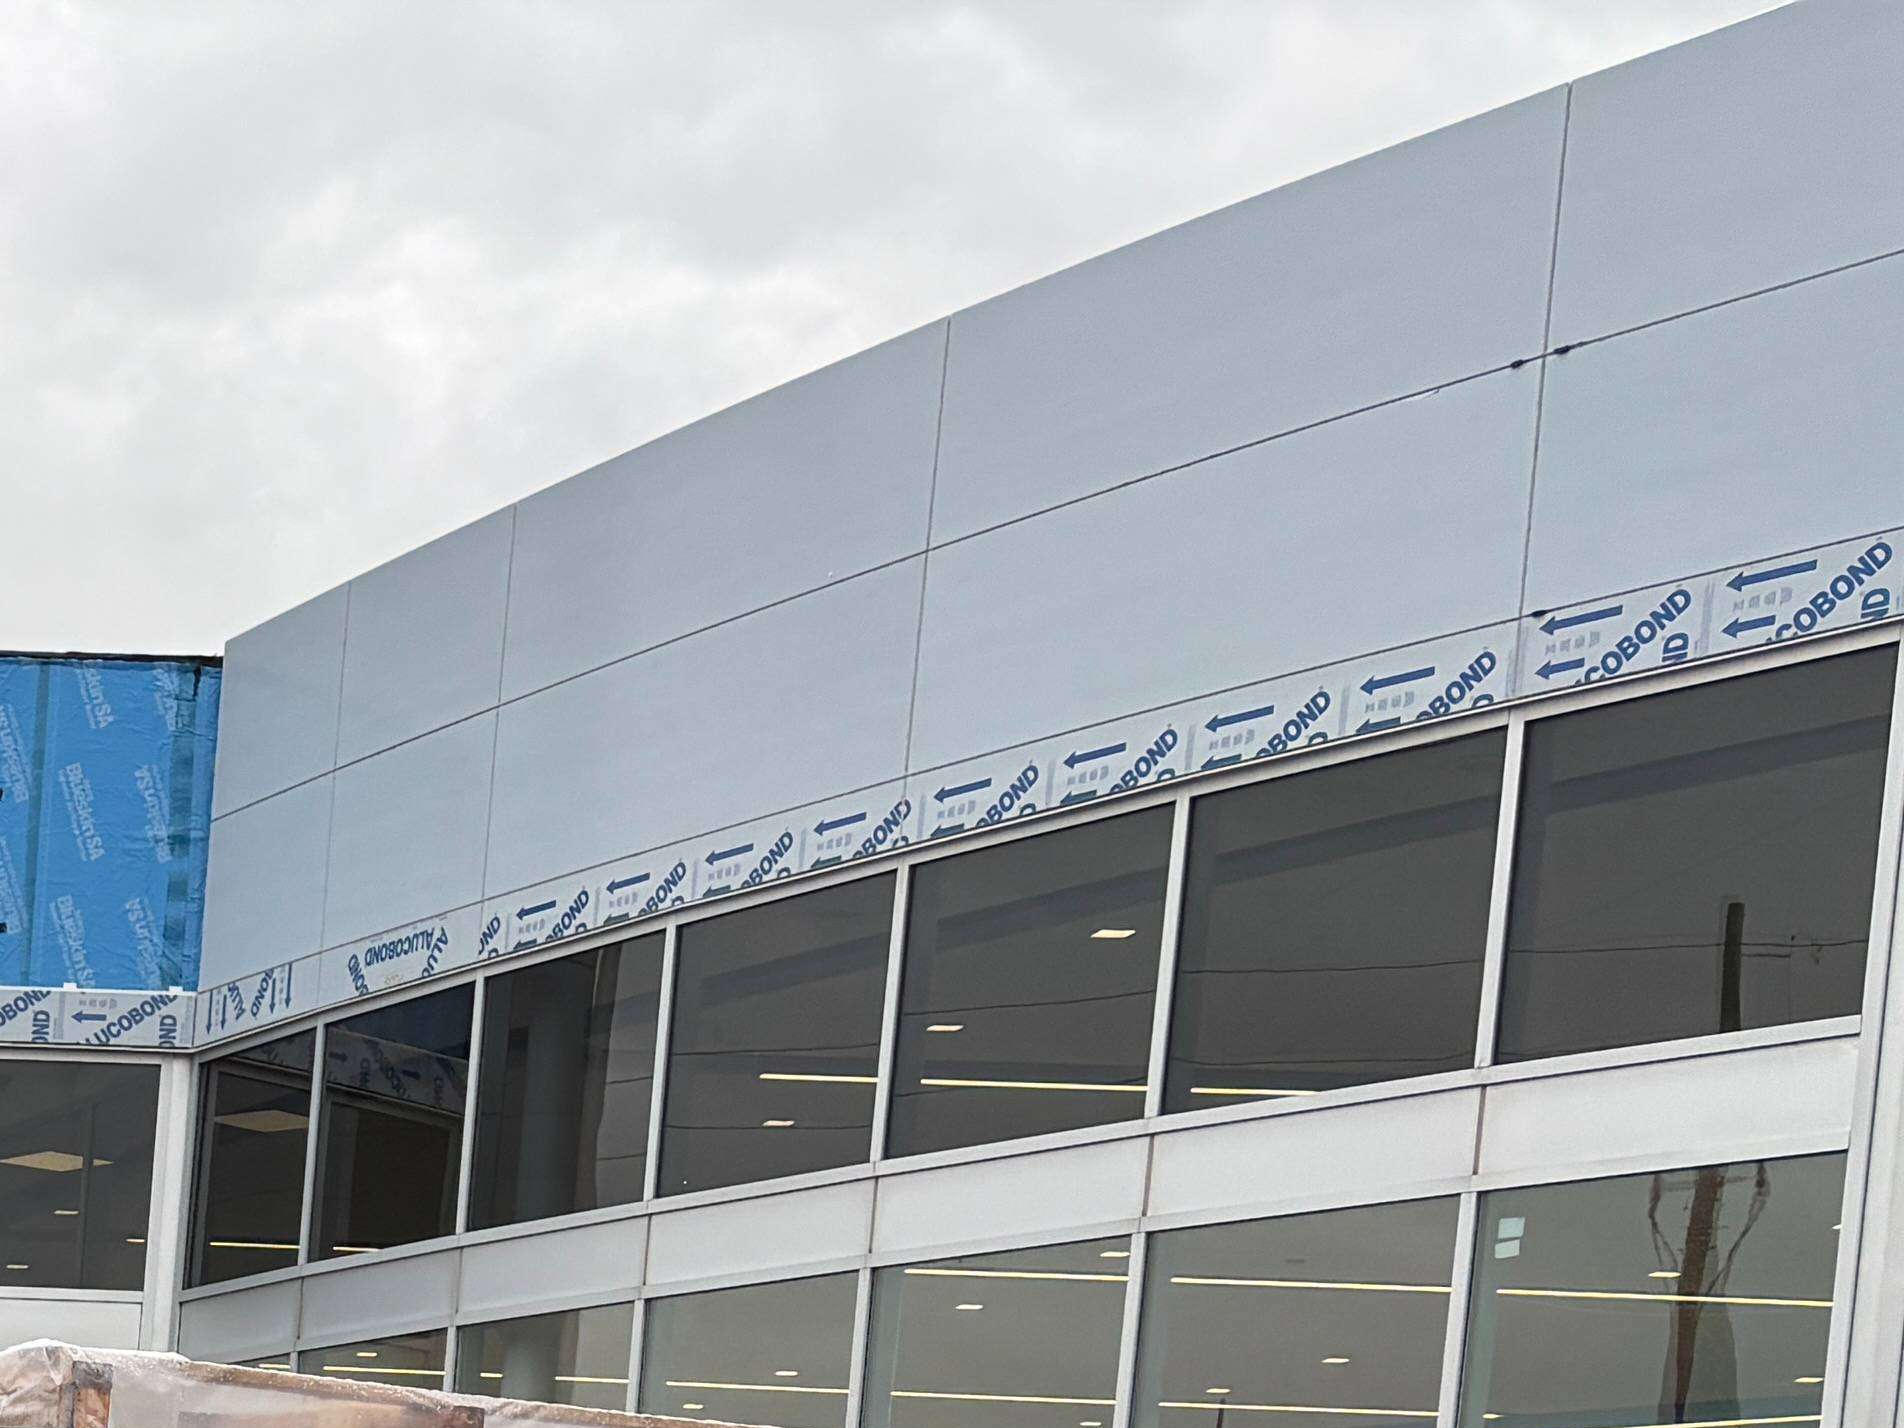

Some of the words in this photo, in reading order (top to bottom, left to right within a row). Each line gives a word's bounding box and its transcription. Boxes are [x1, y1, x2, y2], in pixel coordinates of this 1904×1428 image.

[1575, 589, 1691, 686] COBOND
[1765, 542, 1892, 643] COBOND
[364, 927, 434, 967] ALUCOBOND
